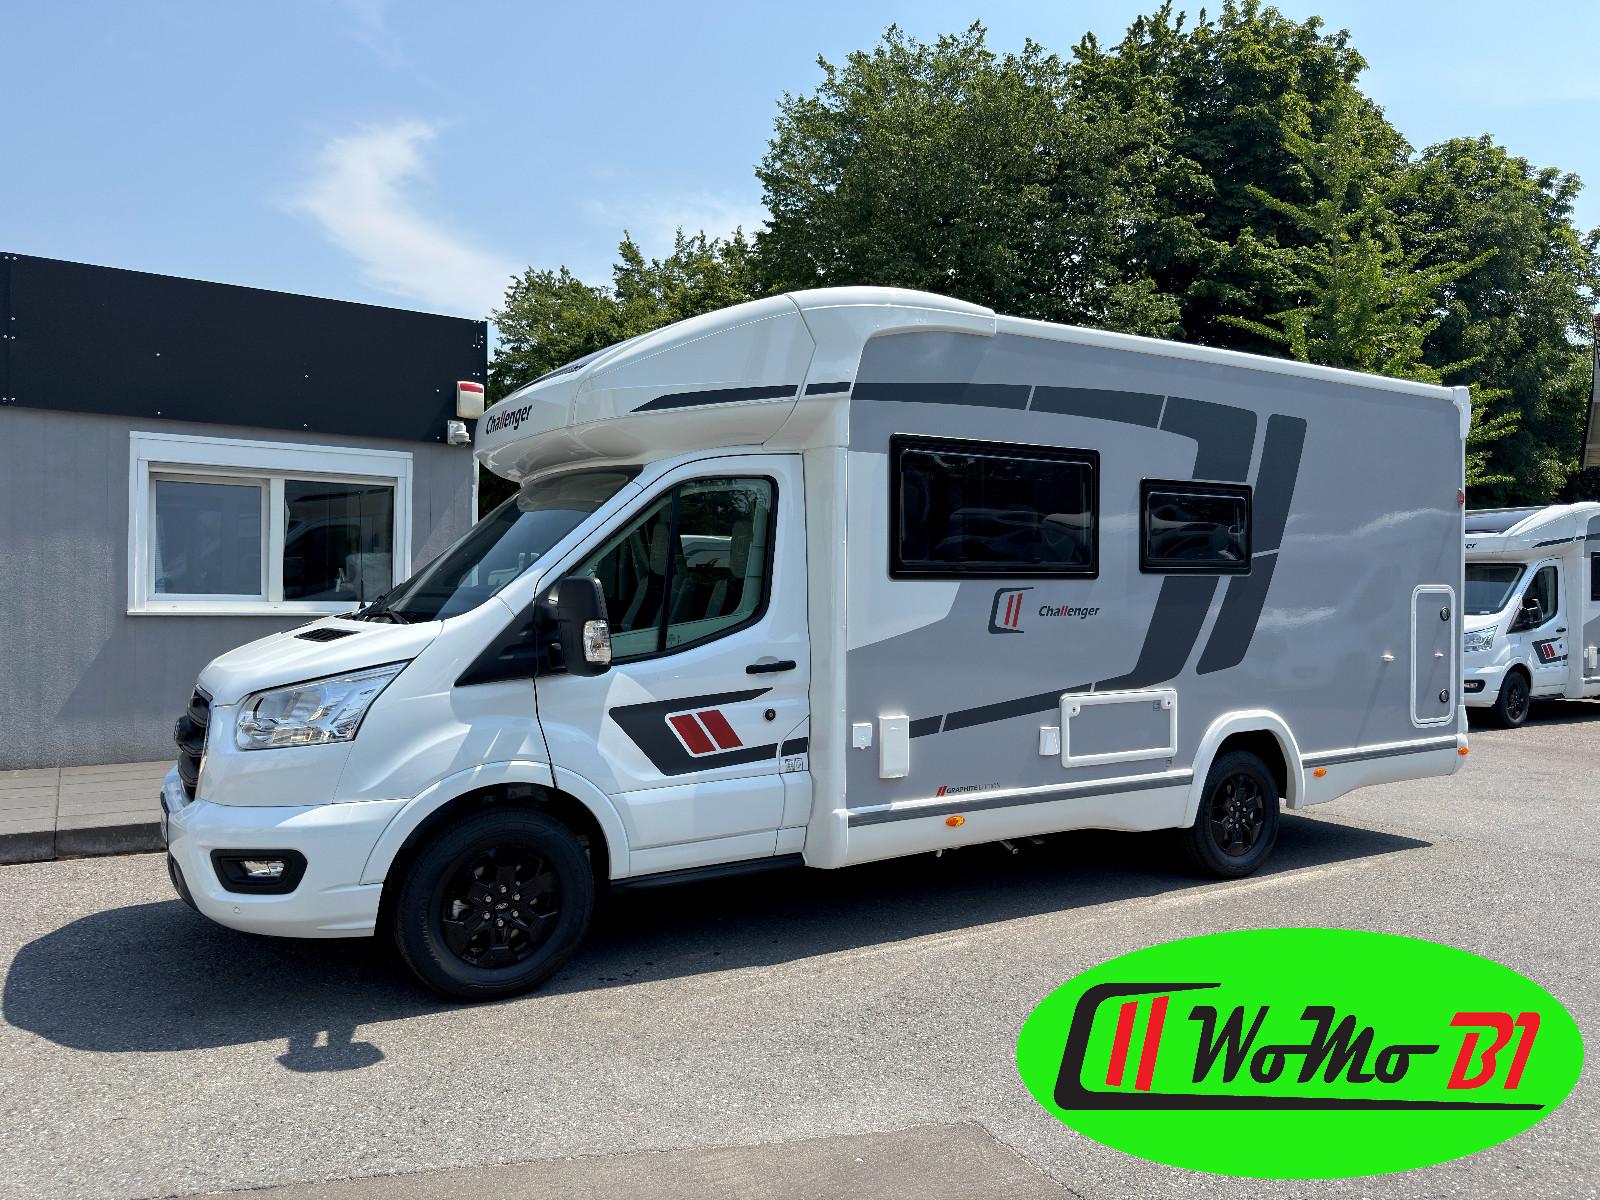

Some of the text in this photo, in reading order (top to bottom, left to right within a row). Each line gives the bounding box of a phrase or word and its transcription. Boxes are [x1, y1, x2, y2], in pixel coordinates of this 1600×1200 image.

[486, 404, 533, 435] Challenger
[1038, 605, 1100, 620] Challenger
[946, 784, 978, 794] GRAPHITE
